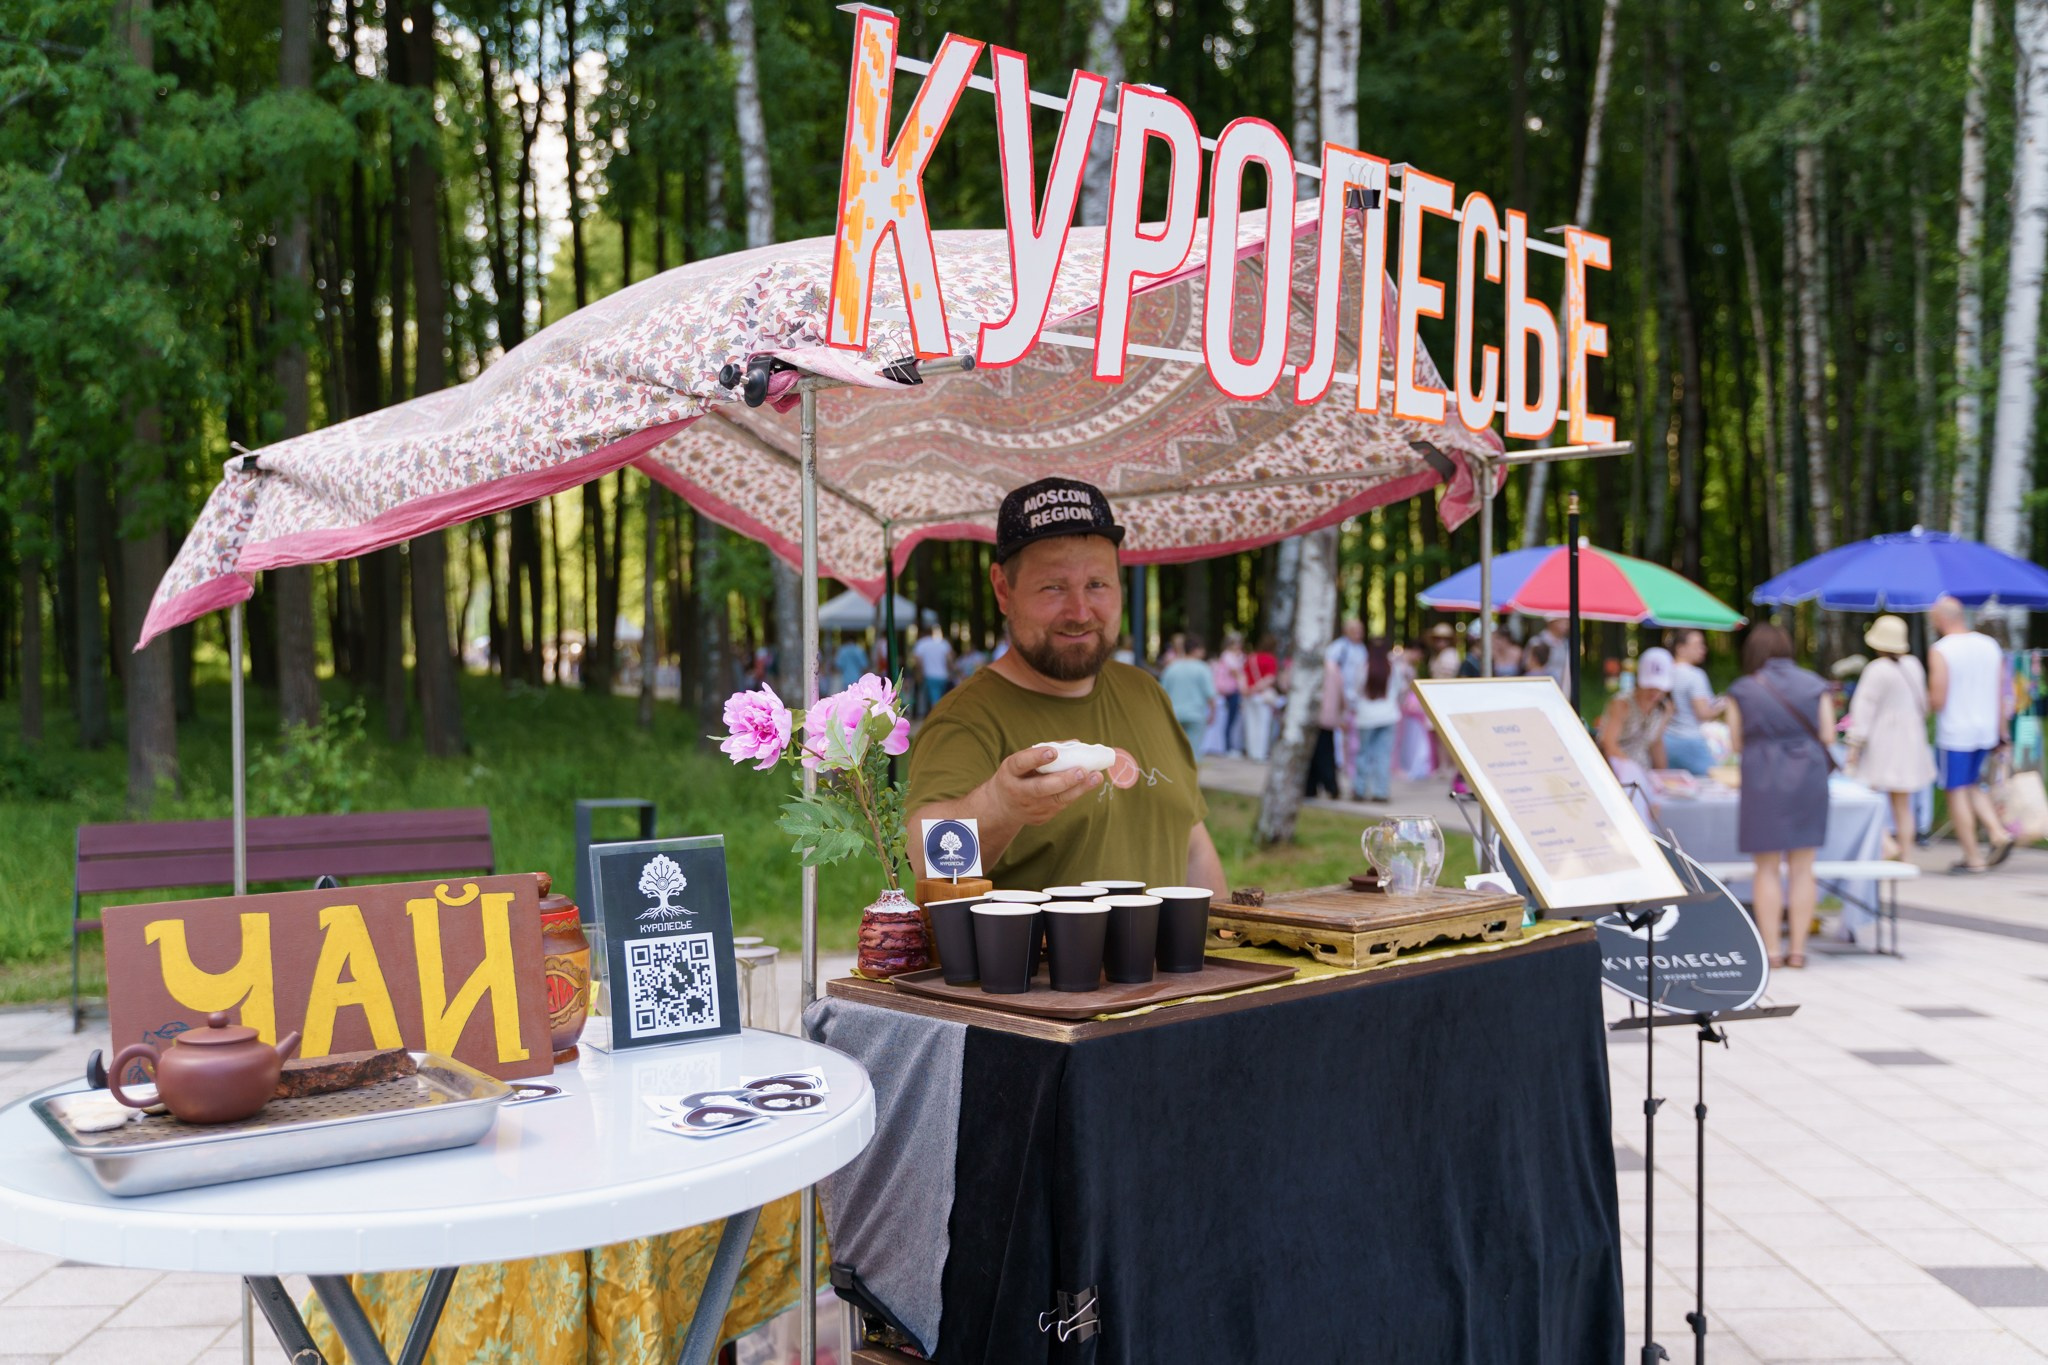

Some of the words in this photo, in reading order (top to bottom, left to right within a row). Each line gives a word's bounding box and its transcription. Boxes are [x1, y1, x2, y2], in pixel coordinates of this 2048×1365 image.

[826, 8, 1616, 446] КУРОЛЕСЬЕ
[1024, 489, 1092, 514] MOSCOW
[1030, 506, 1094, 529] REGION
[639, 920, 693, 934] КУРОЛЕСЬЕ
[1601, 951, 1748, 971] КУРОЛЕСЬЕ
[144, 883, 530, 1064] ЧАЙ
